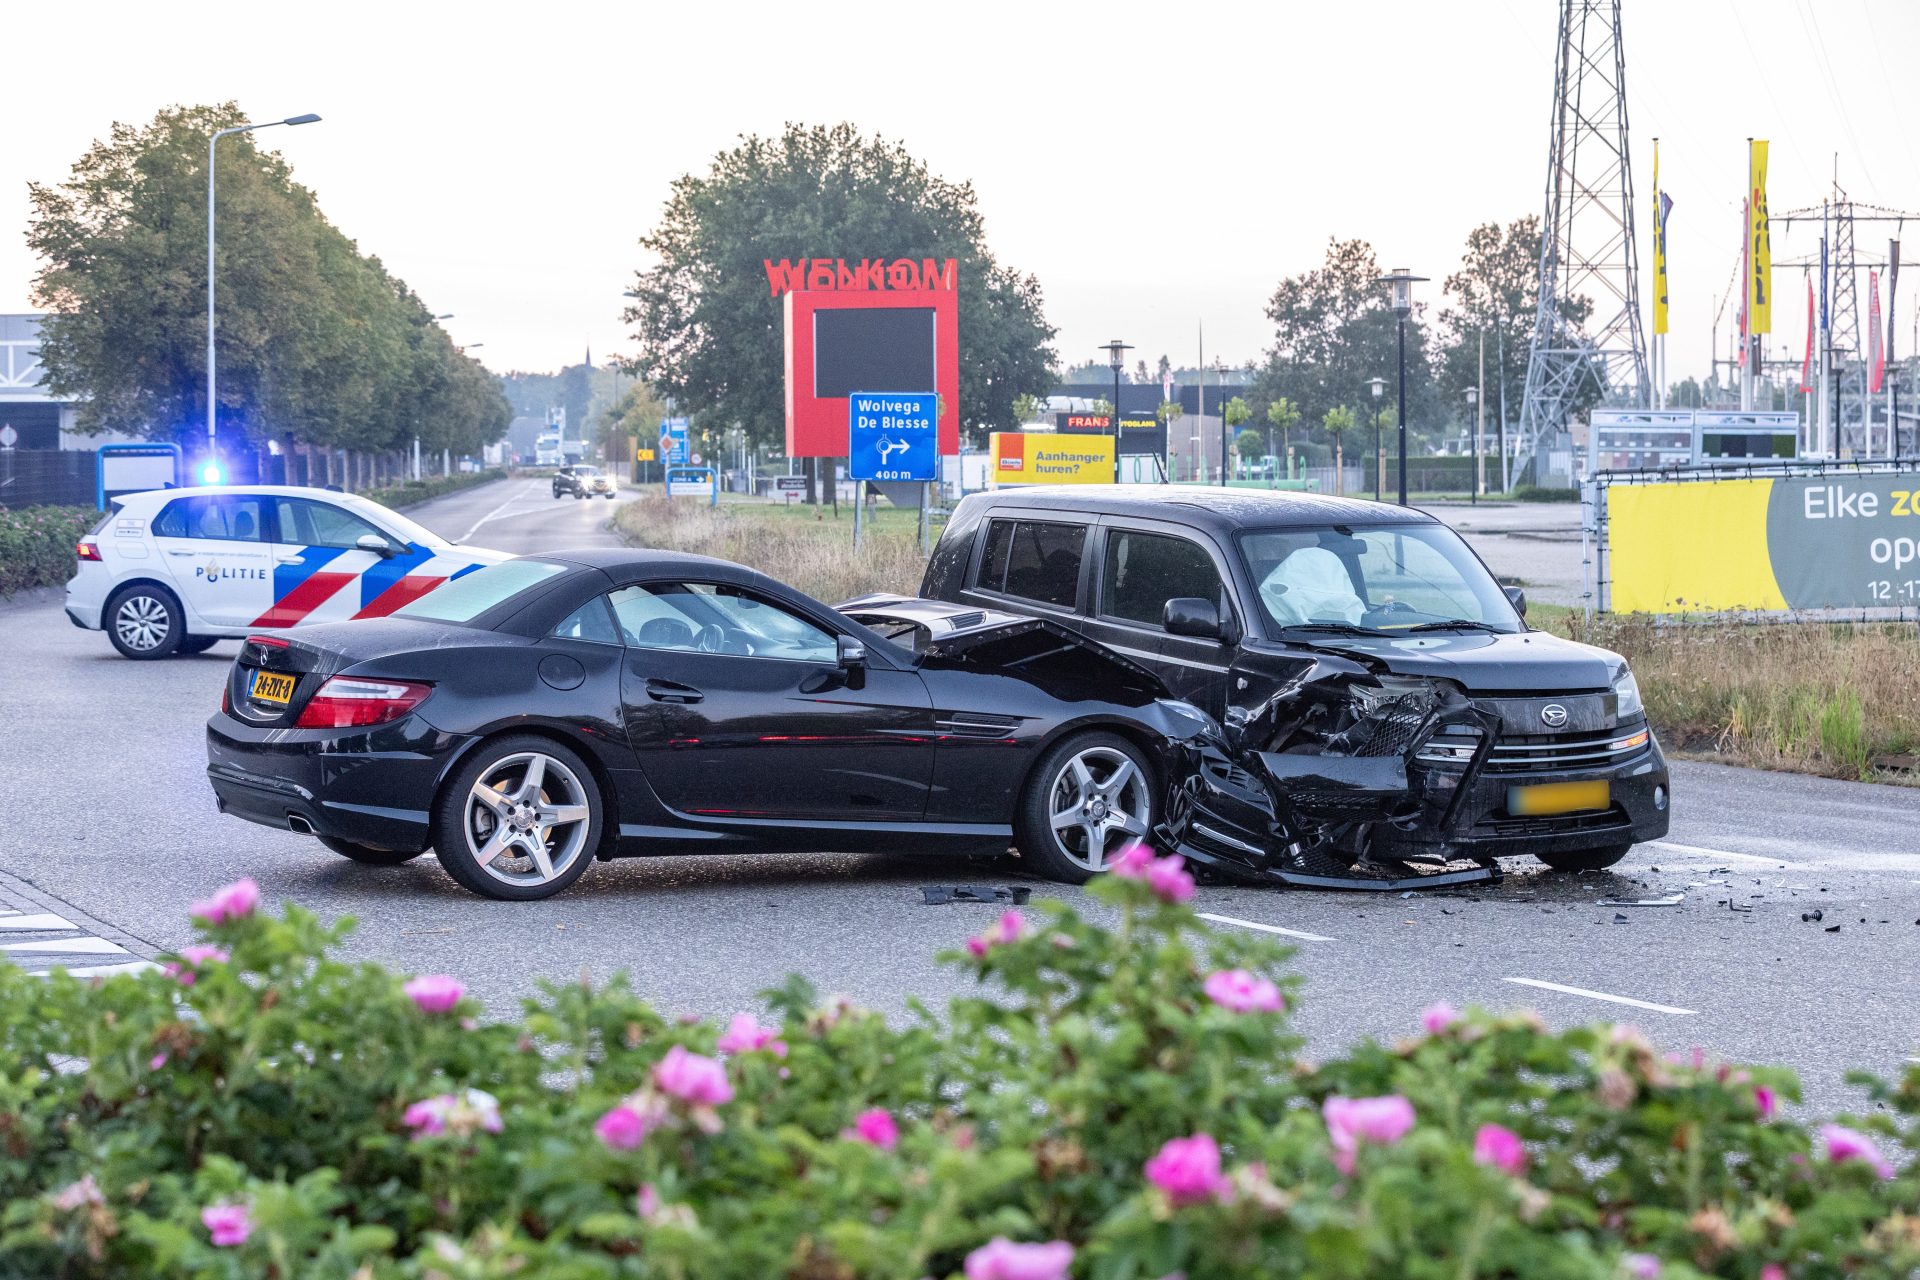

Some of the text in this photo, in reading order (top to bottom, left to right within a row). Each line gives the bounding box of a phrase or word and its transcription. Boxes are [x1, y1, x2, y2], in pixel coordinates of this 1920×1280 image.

[858, 399, 921, 416] Wolvega
[858, 416, 929, 429] De Blesse
[1067, 416, 1110, 428] FRANS
[1035, 451, 1106, 464] Aanhanger
[875, 470, 911, 480] 400 m
[1035, 463, 1081, 474] huren?
[1804, 485, 1878, 519] Elke
[1870, 537, 1920, 571] op
[196, 566, 266, 583] POLITIE
[1867, 581, 1891, 599] 12
